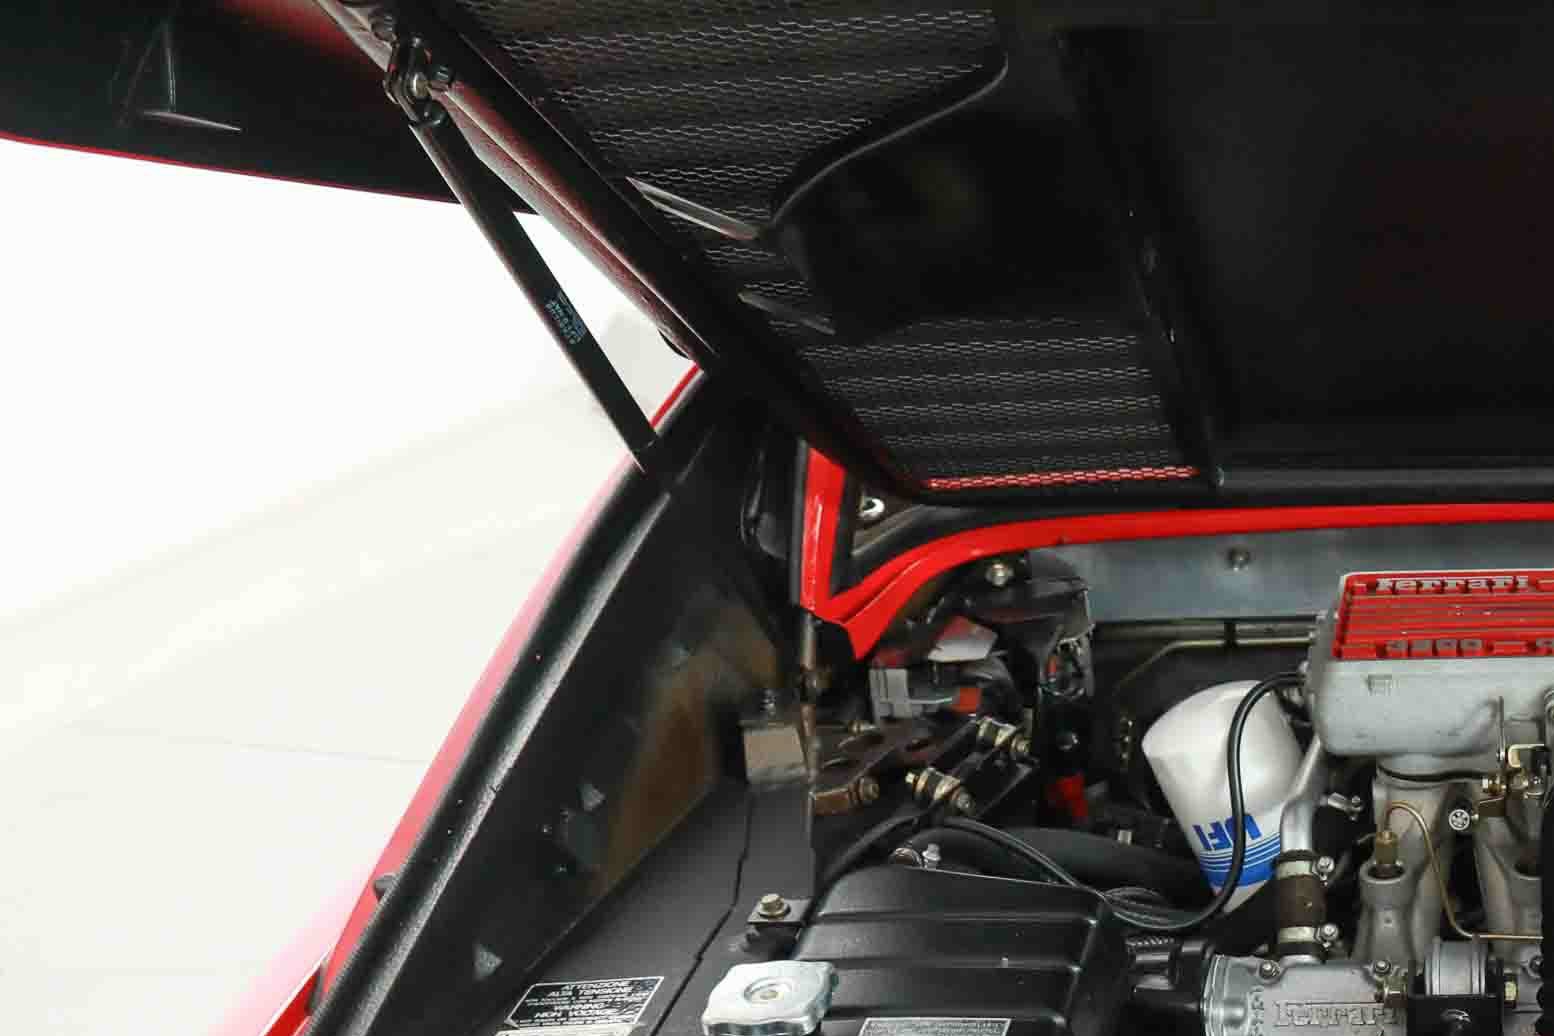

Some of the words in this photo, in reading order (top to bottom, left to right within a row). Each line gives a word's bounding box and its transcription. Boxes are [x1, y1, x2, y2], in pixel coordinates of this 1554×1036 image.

[1376, 575, 1529, 591] Ferrari
[1192, 813, 1262, 851] UFI
[578, 987, 632, 997] TENSIONE
